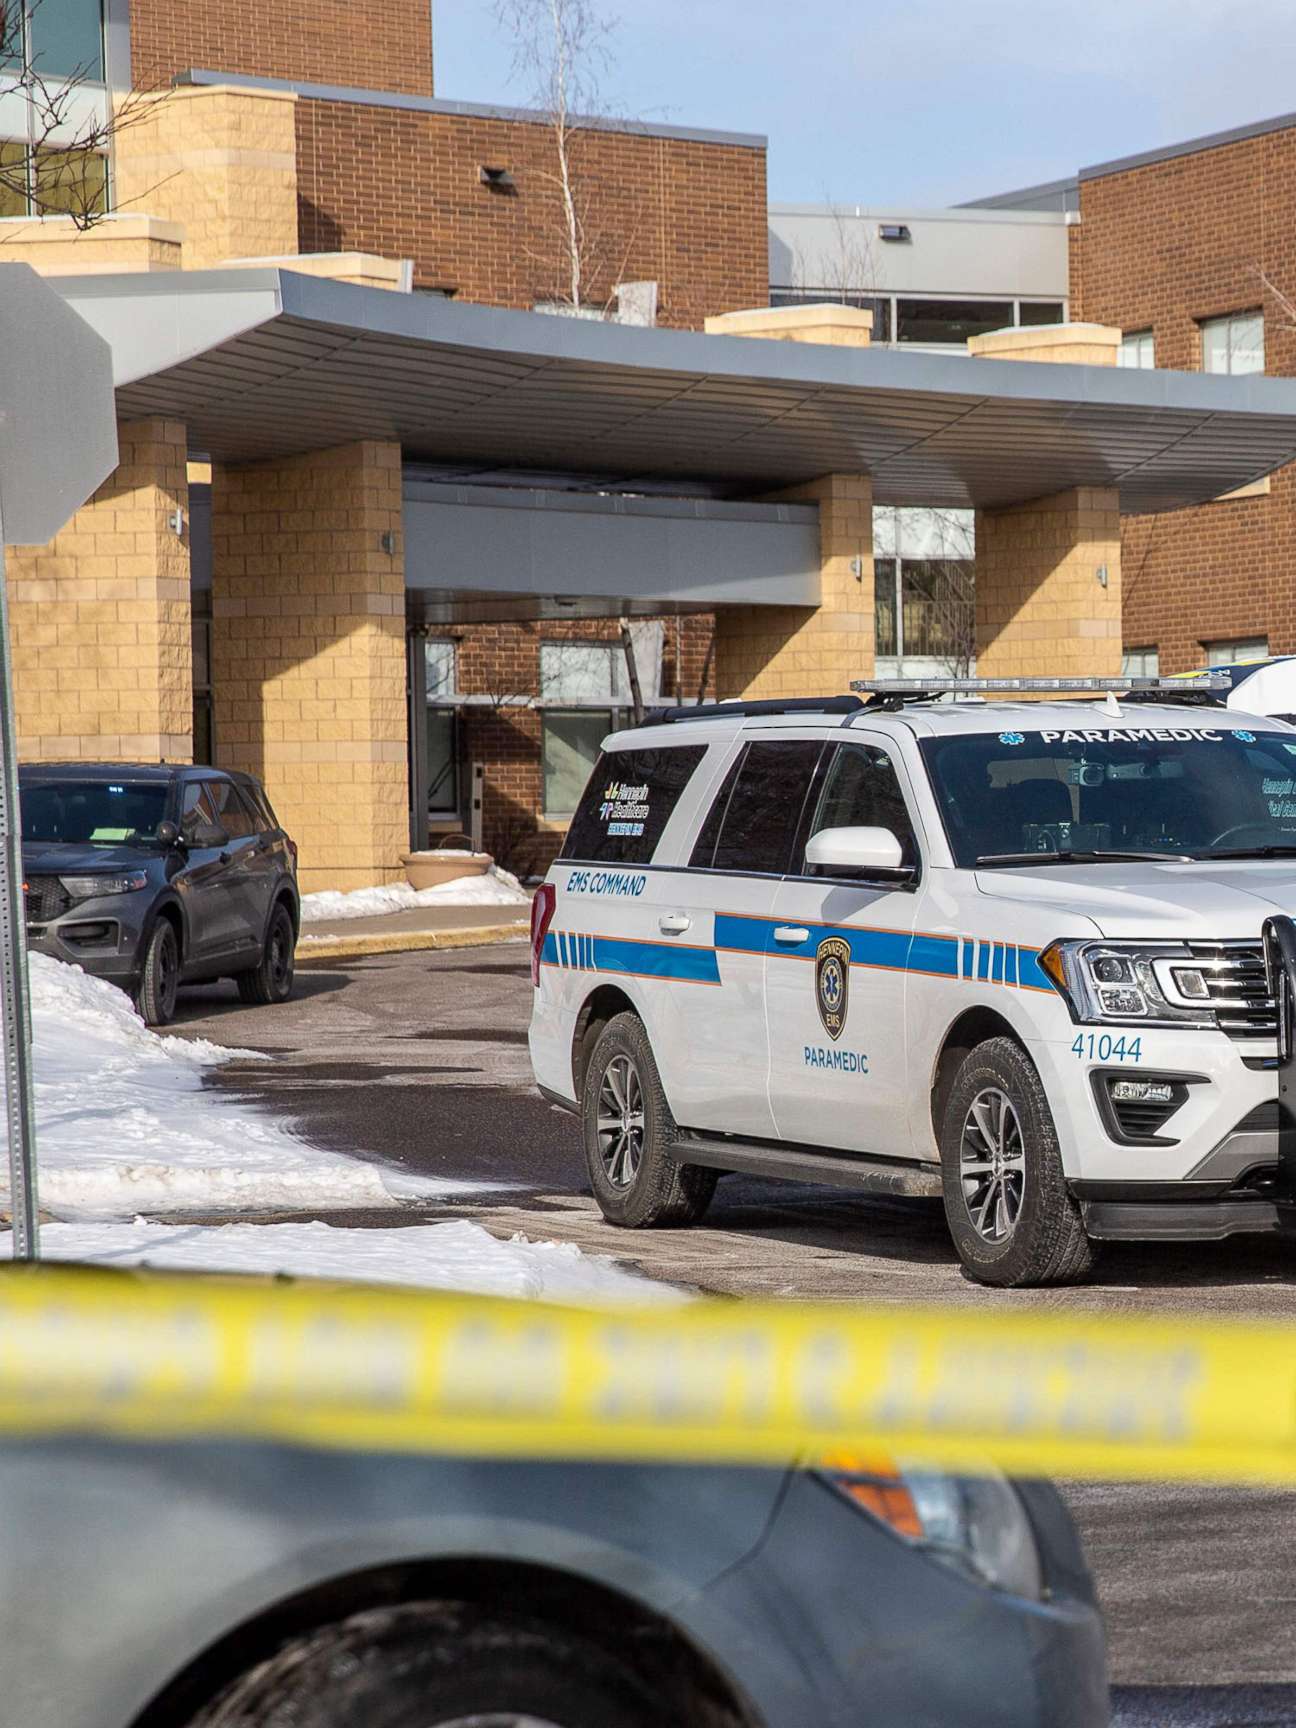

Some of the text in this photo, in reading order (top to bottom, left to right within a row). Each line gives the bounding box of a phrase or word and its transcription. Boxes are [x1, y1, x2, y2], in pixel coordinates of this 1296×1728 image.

[1040, 729, 1223, 744] PARAMEDIC
[567, 871, 647, 897] EMS COMMAND
[819, 941, 850, 965] HENNEPIN
[826, 1013, 841, 1028] EMS
[804, 1046, 869, 1074] PARAMEDIC
[1071, 1033, 1142, 1062] 41044
